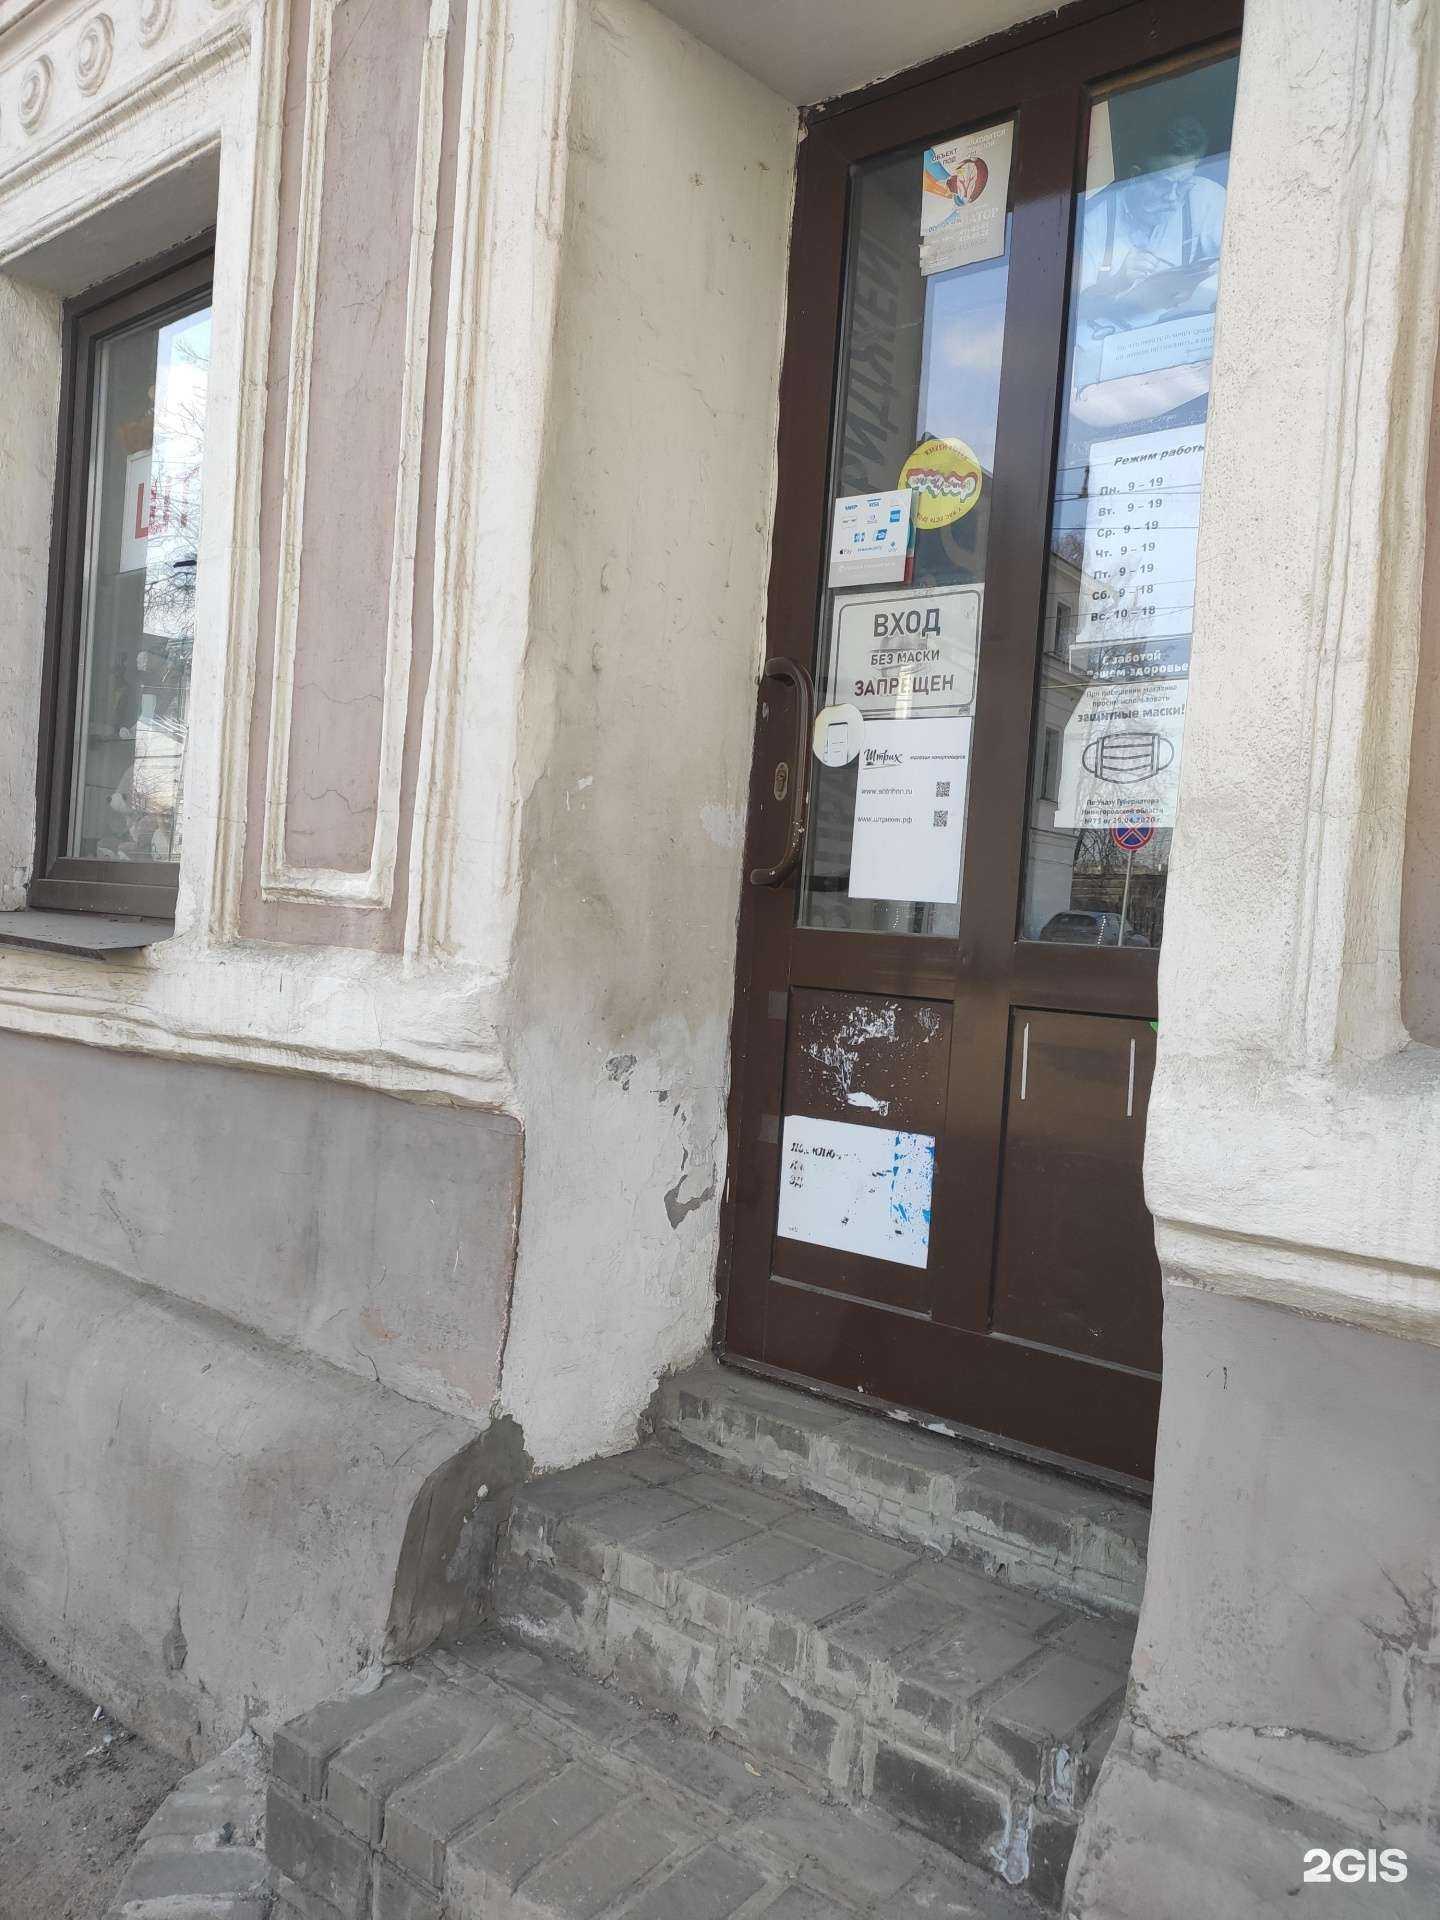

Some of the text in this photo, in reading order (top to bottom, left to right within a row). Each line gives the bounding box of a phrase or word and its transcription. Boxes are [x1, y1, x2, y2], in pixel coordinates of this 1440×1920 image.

[1114, 452, 1157, 466] Режим
[1100, 486, 1120, 496] Пн.
[1128, 482, 1135, 492] 9
[1150, 477, 1164, 487] 19
[1098, 507, 1115, 517] Вт.
[1127, 502, 1134, 513] 9
[1148, 498, 1162, 509] 19
[1097, 528, 1115, 538] Ср.
[1124, 525, 1130, 534] 9
[1145, 521, 1159, 531] 19
[1096, 549, 1112, 558] Чт.
[1120, 546, 1127, 555] 9
[1142, 542, 1155, 552] 19
[1094, 570, 1111, 580] Пт.
[1119, 567, 1126, 576] 9
[1140, 563, 1154, 574] 19
[1092, 591, 1111, 600] Сб.
[1119, 588, 1125, 598] 9
[1140, 584, 1154, 595] 18
[874, 608, 941, 637] ВХОД
[1091, 612, 1109, 622] Вс.
[1113, 609, 1128, 619] 10
[1142, 606, 1155, 616] 18
[871, 650, 941, 666] БЕЗ МАСКИ
[1113, 650, 1161, 664] заботой
[1130, 663, 1189, 676] здоровье
[855, 674, 954, 697] ЗАПРЕЩЕН
[1077, 704, 1186, 722] защитные маски!
[864, 749, 903, 767] Штрих
